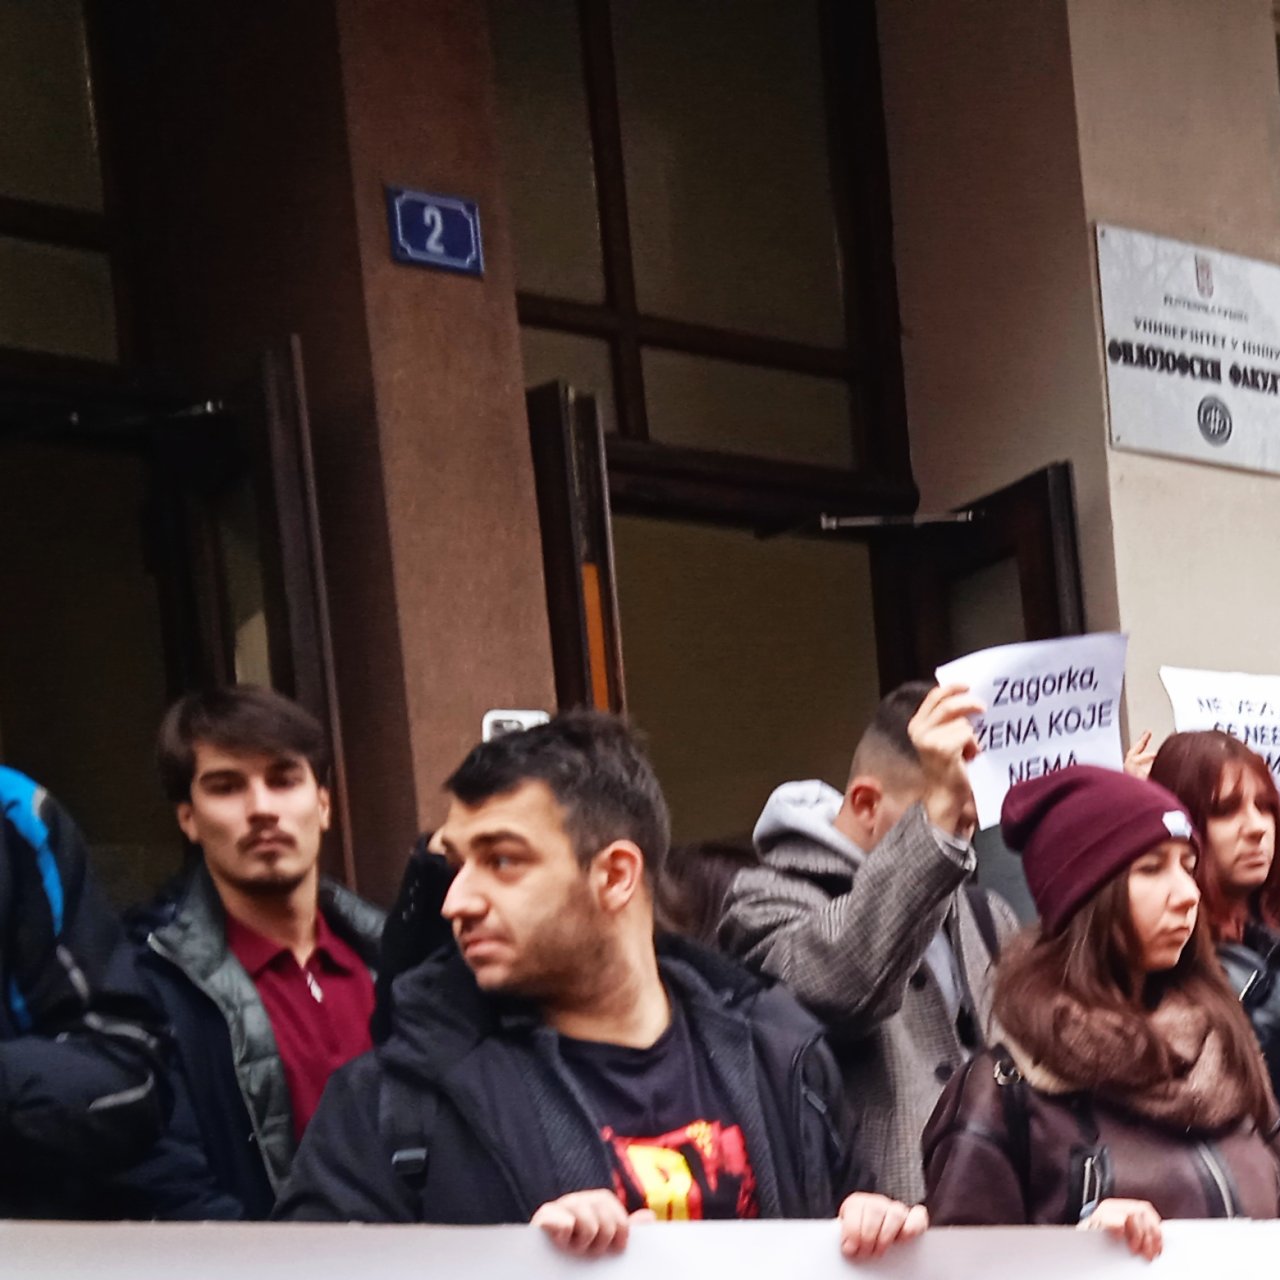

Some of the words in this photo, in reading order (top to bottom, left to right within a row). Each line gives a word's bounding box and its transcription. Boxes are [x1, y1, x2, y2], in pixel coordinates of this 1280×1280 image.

[423, 205, 445, 254] 2
[1107, 338, 1222, 383] ФИЛОЗОФСКИ
[993, 665, 1099, 707] Zagorka,
[975, 714, 1040, 751] ŽENA
[1048, 699, 1113, 738] KOJE
